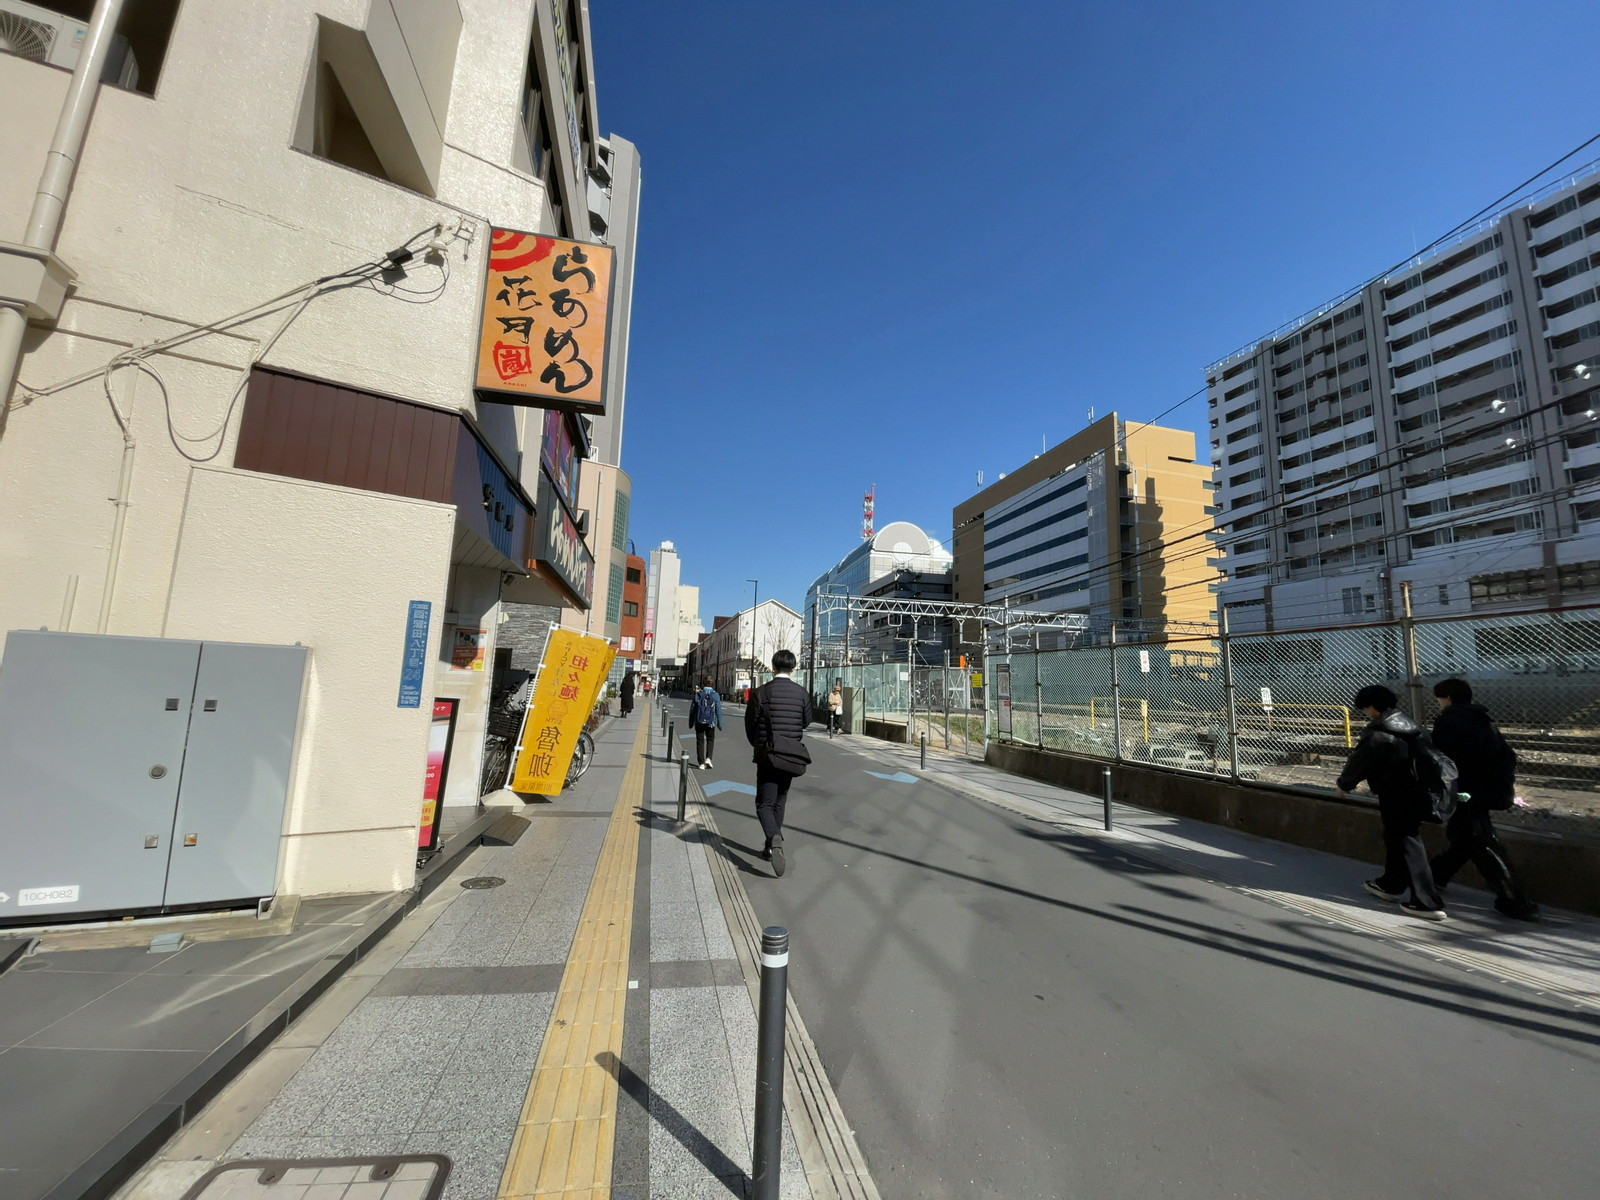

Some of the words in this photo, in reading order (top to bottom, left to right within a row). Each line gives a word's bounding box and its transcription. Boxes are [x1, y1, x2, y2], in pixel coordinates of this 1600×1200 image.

[540, 245, 596, 394] らあめん
[23, 889, 73, 902] 10CH082
